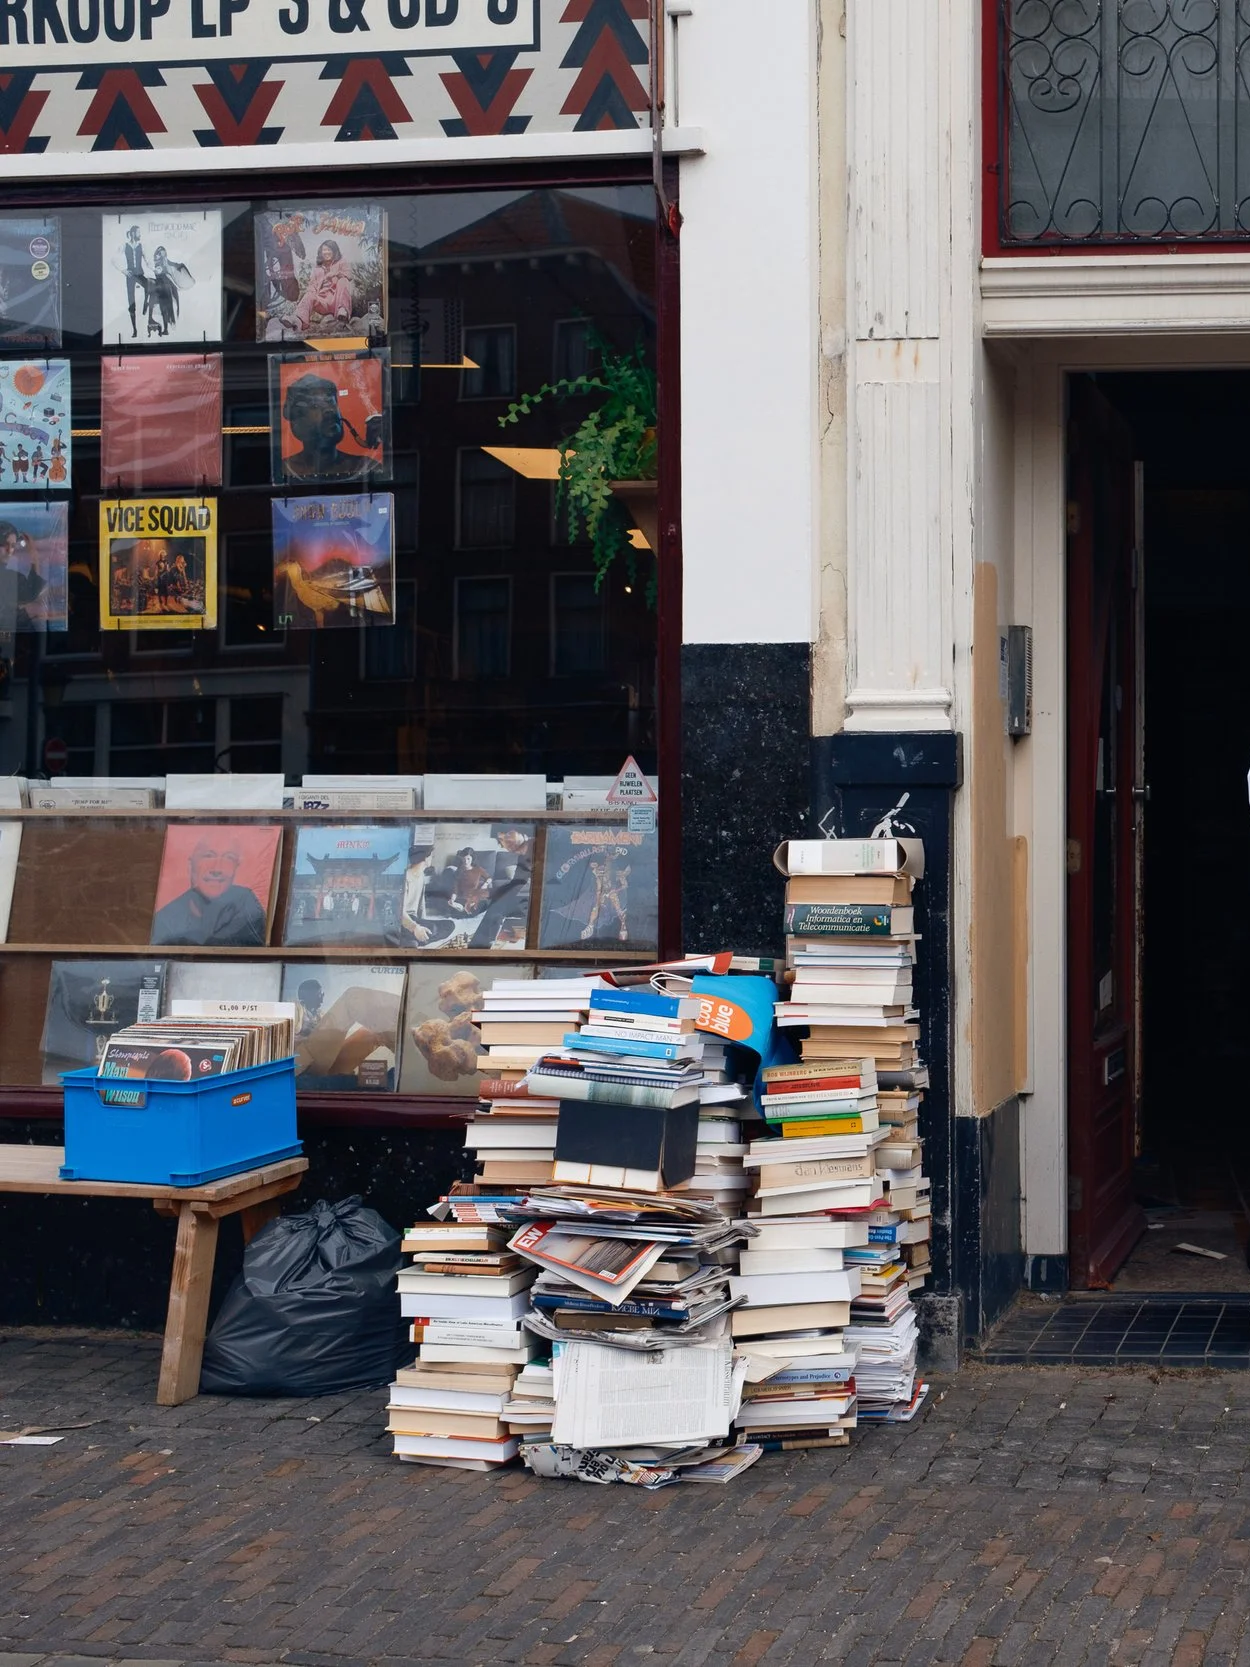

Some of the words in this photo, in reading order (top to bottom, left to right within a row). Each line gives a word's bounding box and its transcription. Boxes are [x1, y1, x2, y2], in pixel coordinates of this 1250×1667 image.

[106, 506, 145, 532] VICE
[148, 504, 211, 534] SQUAD
[810, 906, 862, 915] Woordenboek
[806, 914, 851, 923] Informatica
[853, 916, 863, 924] en
[798, 922, 871, 932] Telecommunicatie
[371, 966, 405, 975] CURTIS
[242, 1004, 258, 1012] P/ST
[696, 997, 715, 1027] cool
[709, 1004, 734, 1035] blue
[614, 1030, 627, 1038] NO
[629, 1031, 653, 1040] IMPACT
[656, 1034, 673, 1042] MAN
[103, 1060, 131, 1078] Mari
